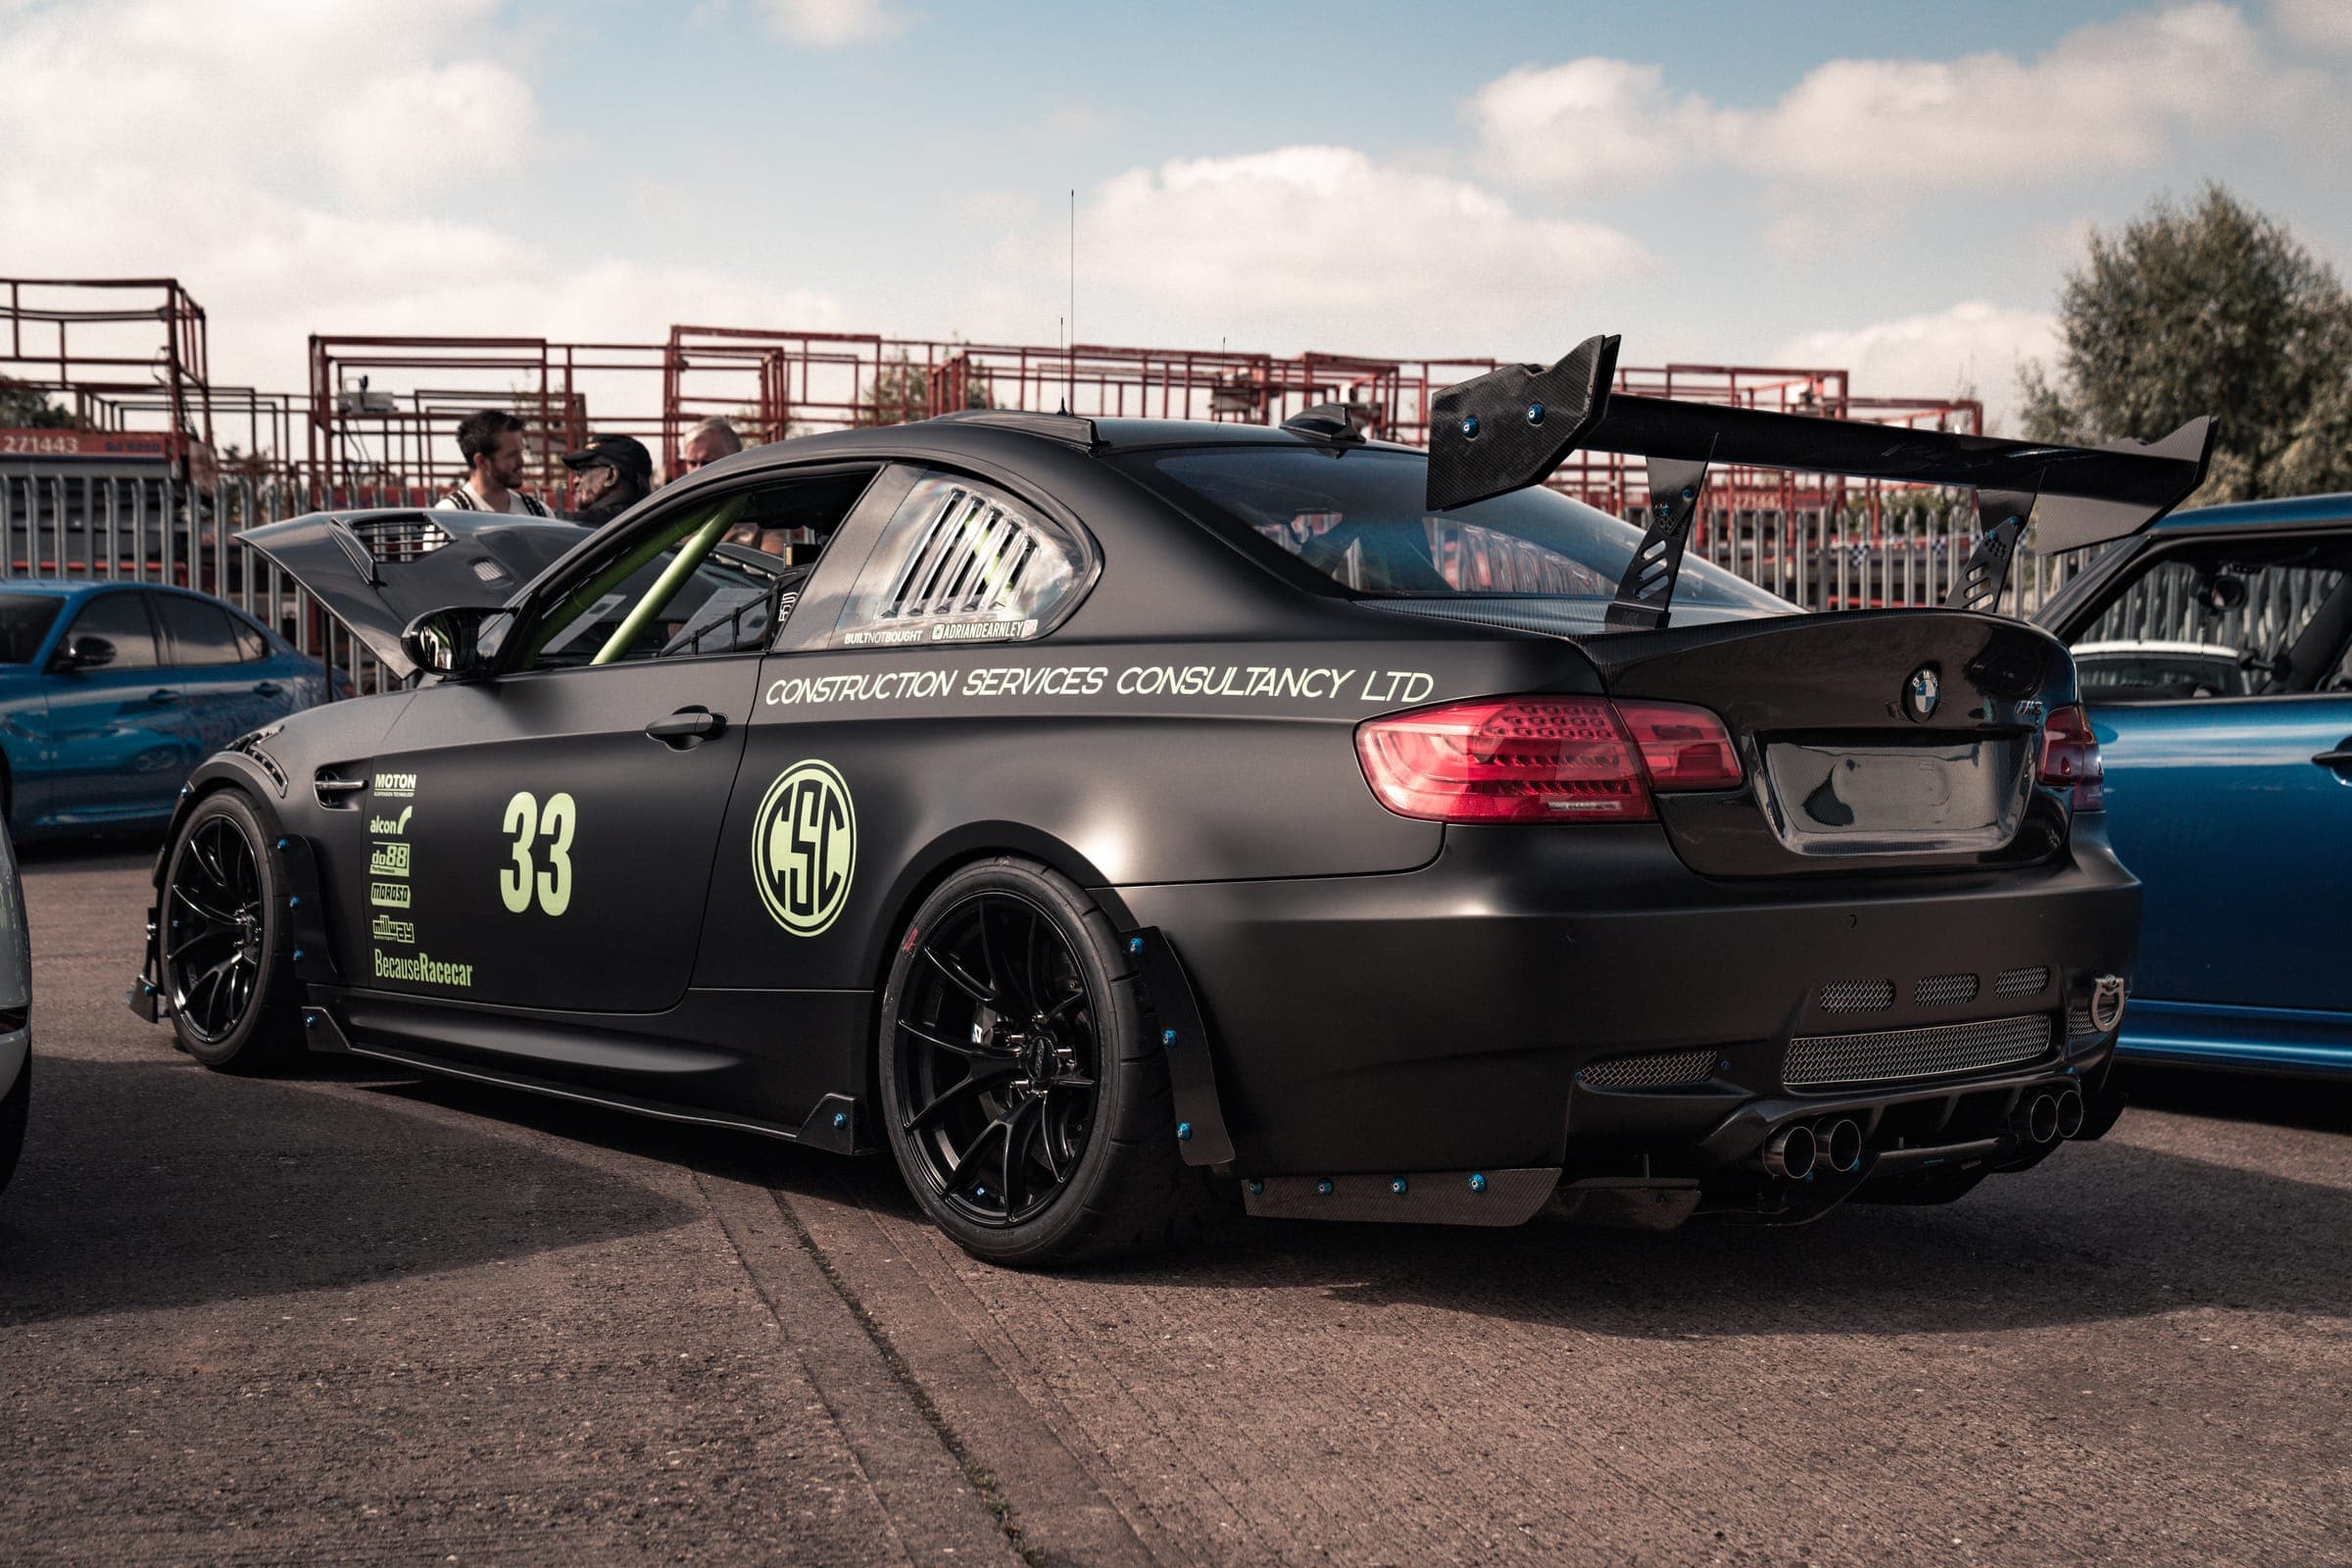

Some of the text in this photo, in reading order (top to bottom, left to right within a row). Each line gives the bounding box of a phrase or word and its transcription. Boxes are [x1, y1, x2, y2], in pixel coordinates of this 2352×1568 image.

[844, 621, 1024, 645] BUILTNOTBOUGHT ADRIANDEARNLEY
[765, 666, 1434, 706] CONSTRUCTION SERVICES CONSULTANCY LTD
[374, 774, 416, 789] MOTON
[369, 814, 398, 835] alcon
[371, 845, 408, 868] do88
[500, 791, 576, 916] 33
[762, 779, 845, 917] CSC
[374, 948, 472, 987] BecauseRacecar
